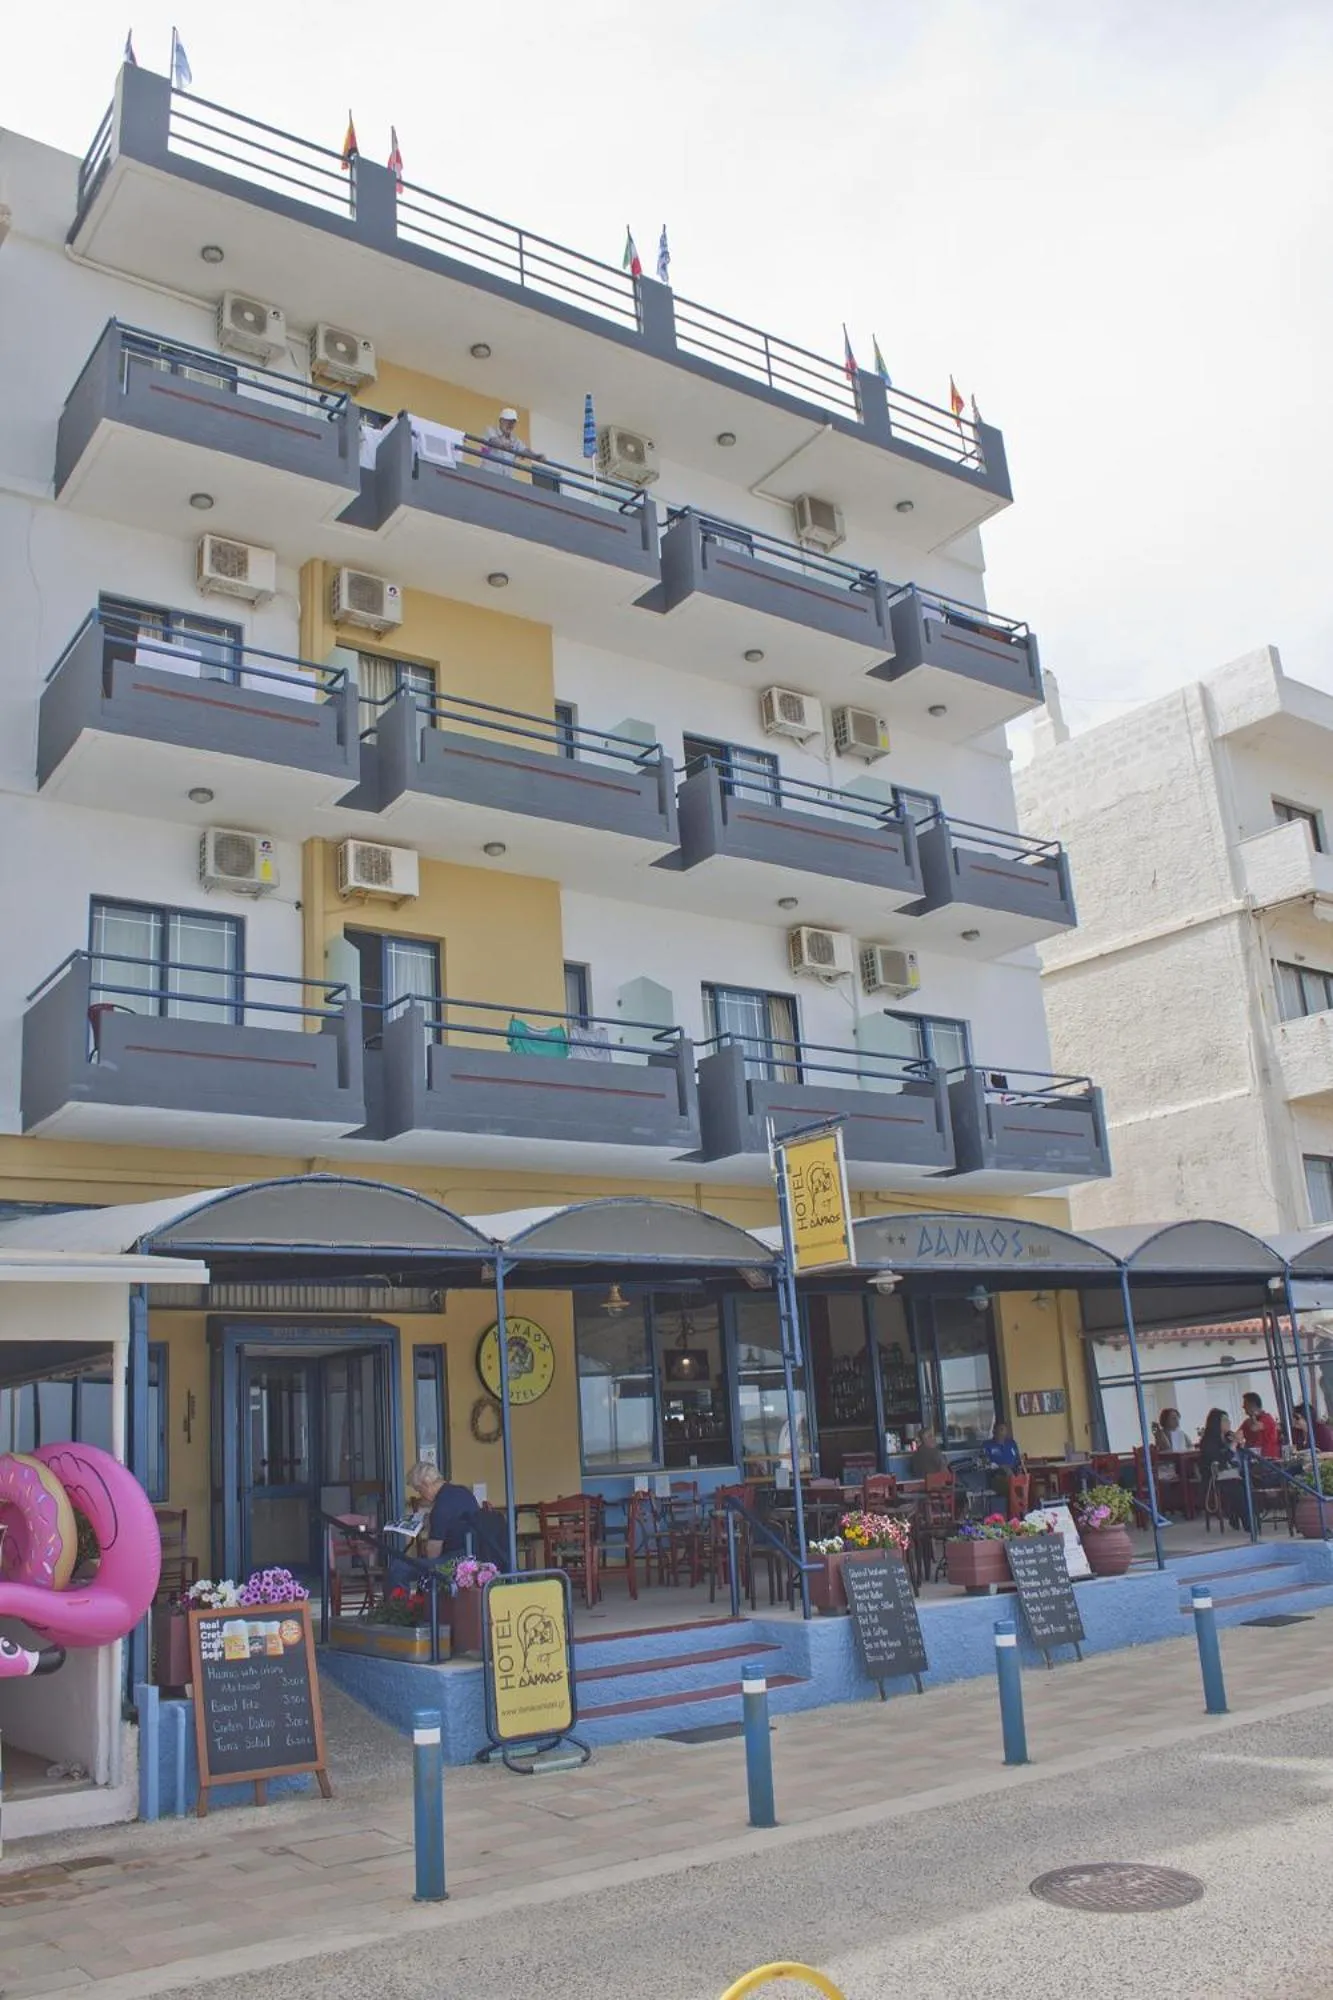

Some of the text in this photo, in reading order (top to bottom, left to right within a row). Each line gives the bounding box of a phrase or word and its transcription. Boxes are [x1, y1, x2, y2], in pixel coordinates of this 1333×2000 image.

[792, 1166, 808, 1231] HOTEL
[200, 1619, 220, 1630] Real
[495, 1610, 515, 1691] HOTEL
